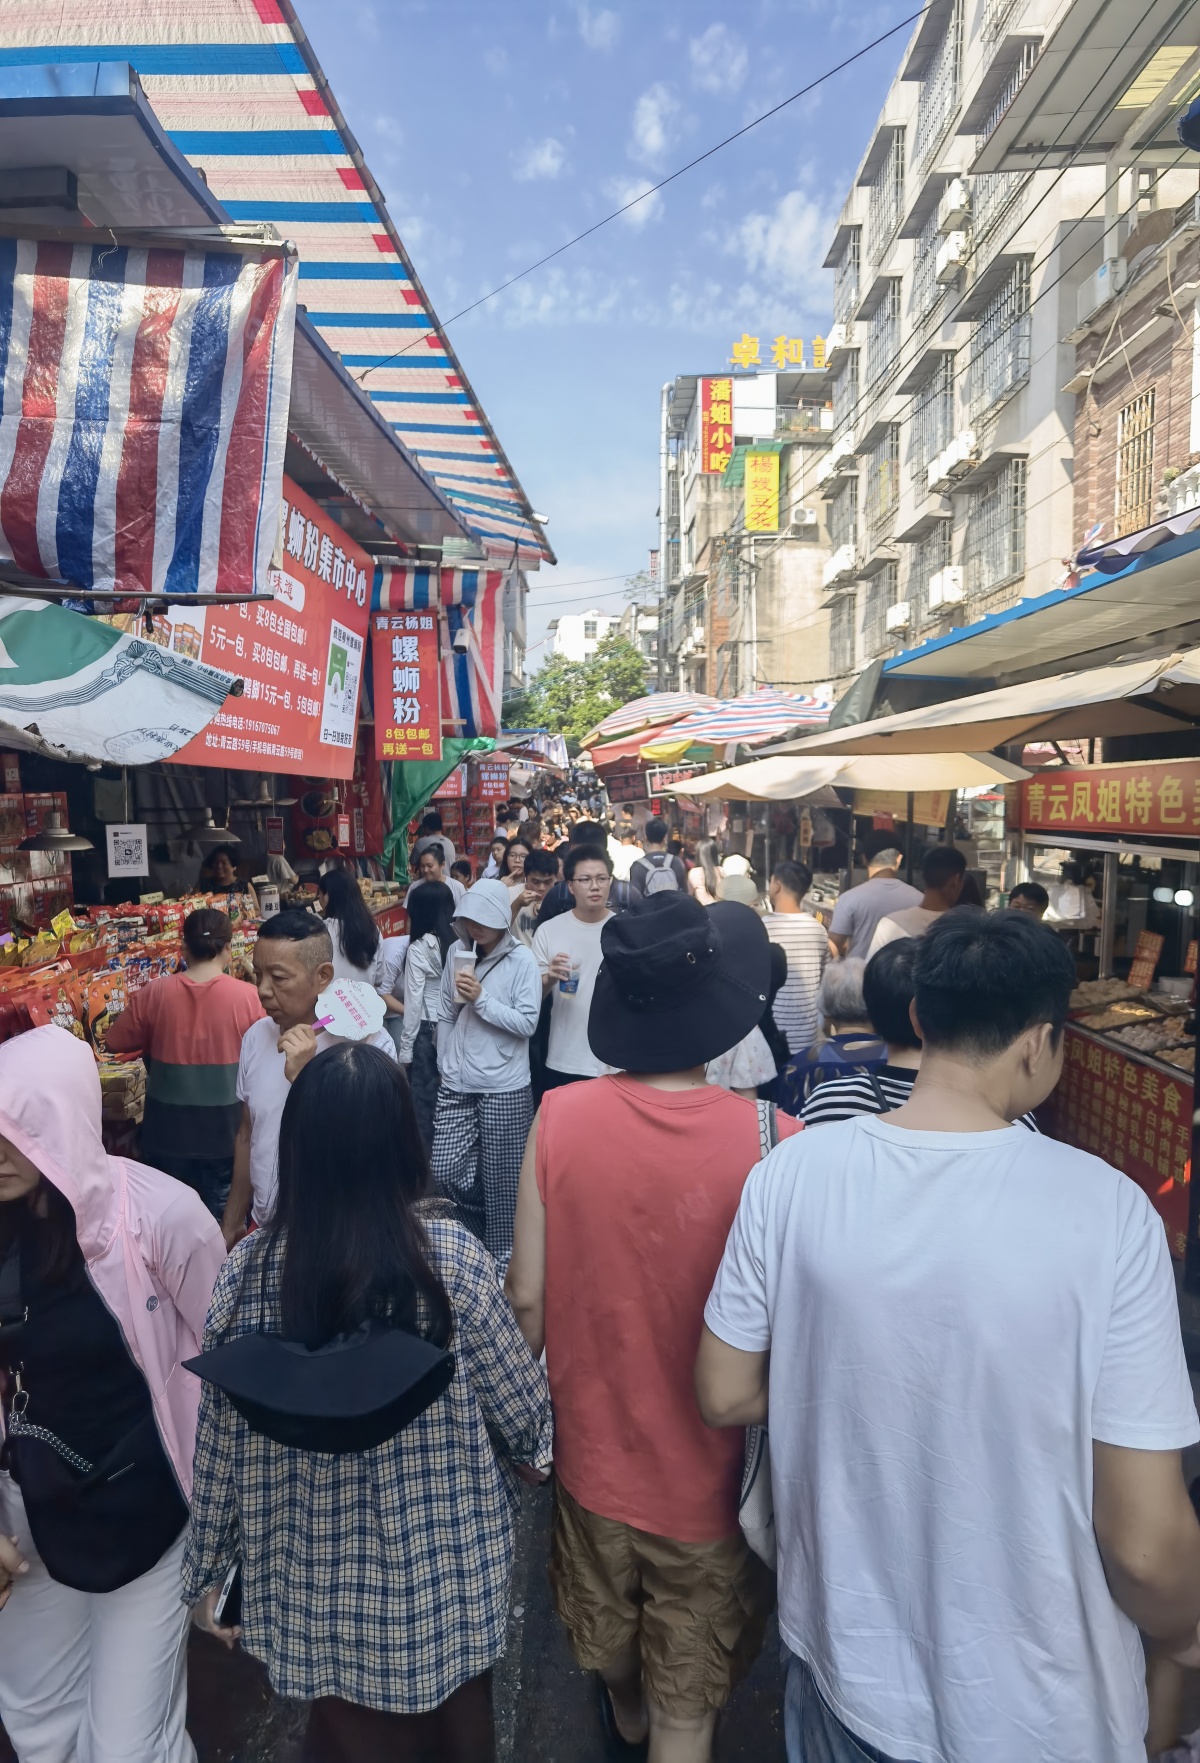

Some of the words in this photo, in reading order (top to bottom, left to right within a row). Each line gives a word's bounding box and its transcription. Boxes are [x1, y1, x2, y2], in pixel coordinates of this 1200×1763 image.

[709, 379, 732, 473] 潘姐小吃
[268, 572, 294, 601] 味道
[375, 616, 434, 630] 青云杨姐
[391, 635, 421, 724] 螺蛳粉
[384, 728, 431, 740] 8包包邮
[382, 742, 434, 756] 再送一包
[264, 901, 280, 912] 绿豆
[1064, 1037, 1182, 1118] 凤姐特色美食
